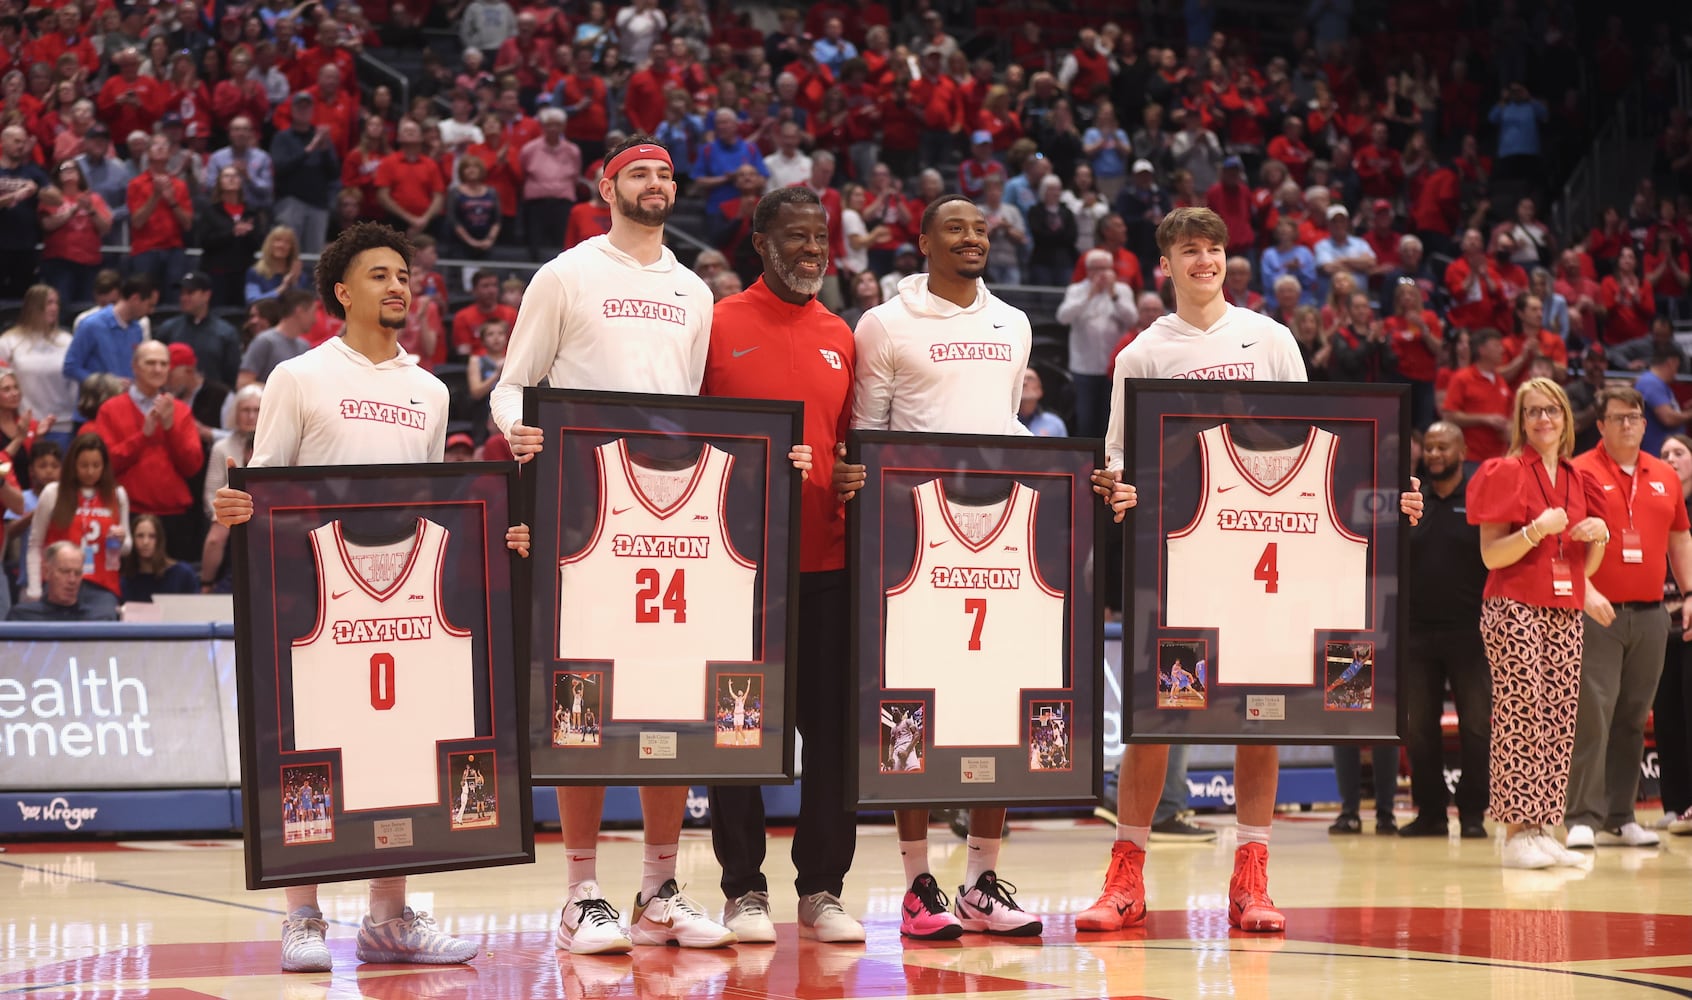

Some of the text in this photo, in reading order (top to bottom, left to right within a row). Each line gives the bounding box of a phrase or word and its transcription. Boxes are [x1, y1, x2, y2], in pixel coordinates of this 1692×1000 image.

[603, 299, 686, 326] DAYTON
[929, 342, 1013, 364] DAYTON
[340, 399, 426, 430] DAYTON
[1216, 509, 1318, 534] DAYTON
[612, 534, 710, 559] DAYTON
[931, 567, 1020, 590] DAYTON
[1253, 542, 1279, 594] 4
[635, 568, 687, 624] 24
[333, 616, 432, 644] DAYTON
[964, 598, 987, 651] 7
[369, 652, 396, 711] 0
[0, 713, 153, 758] ment
[43, 797, 97, 830] Kroger
